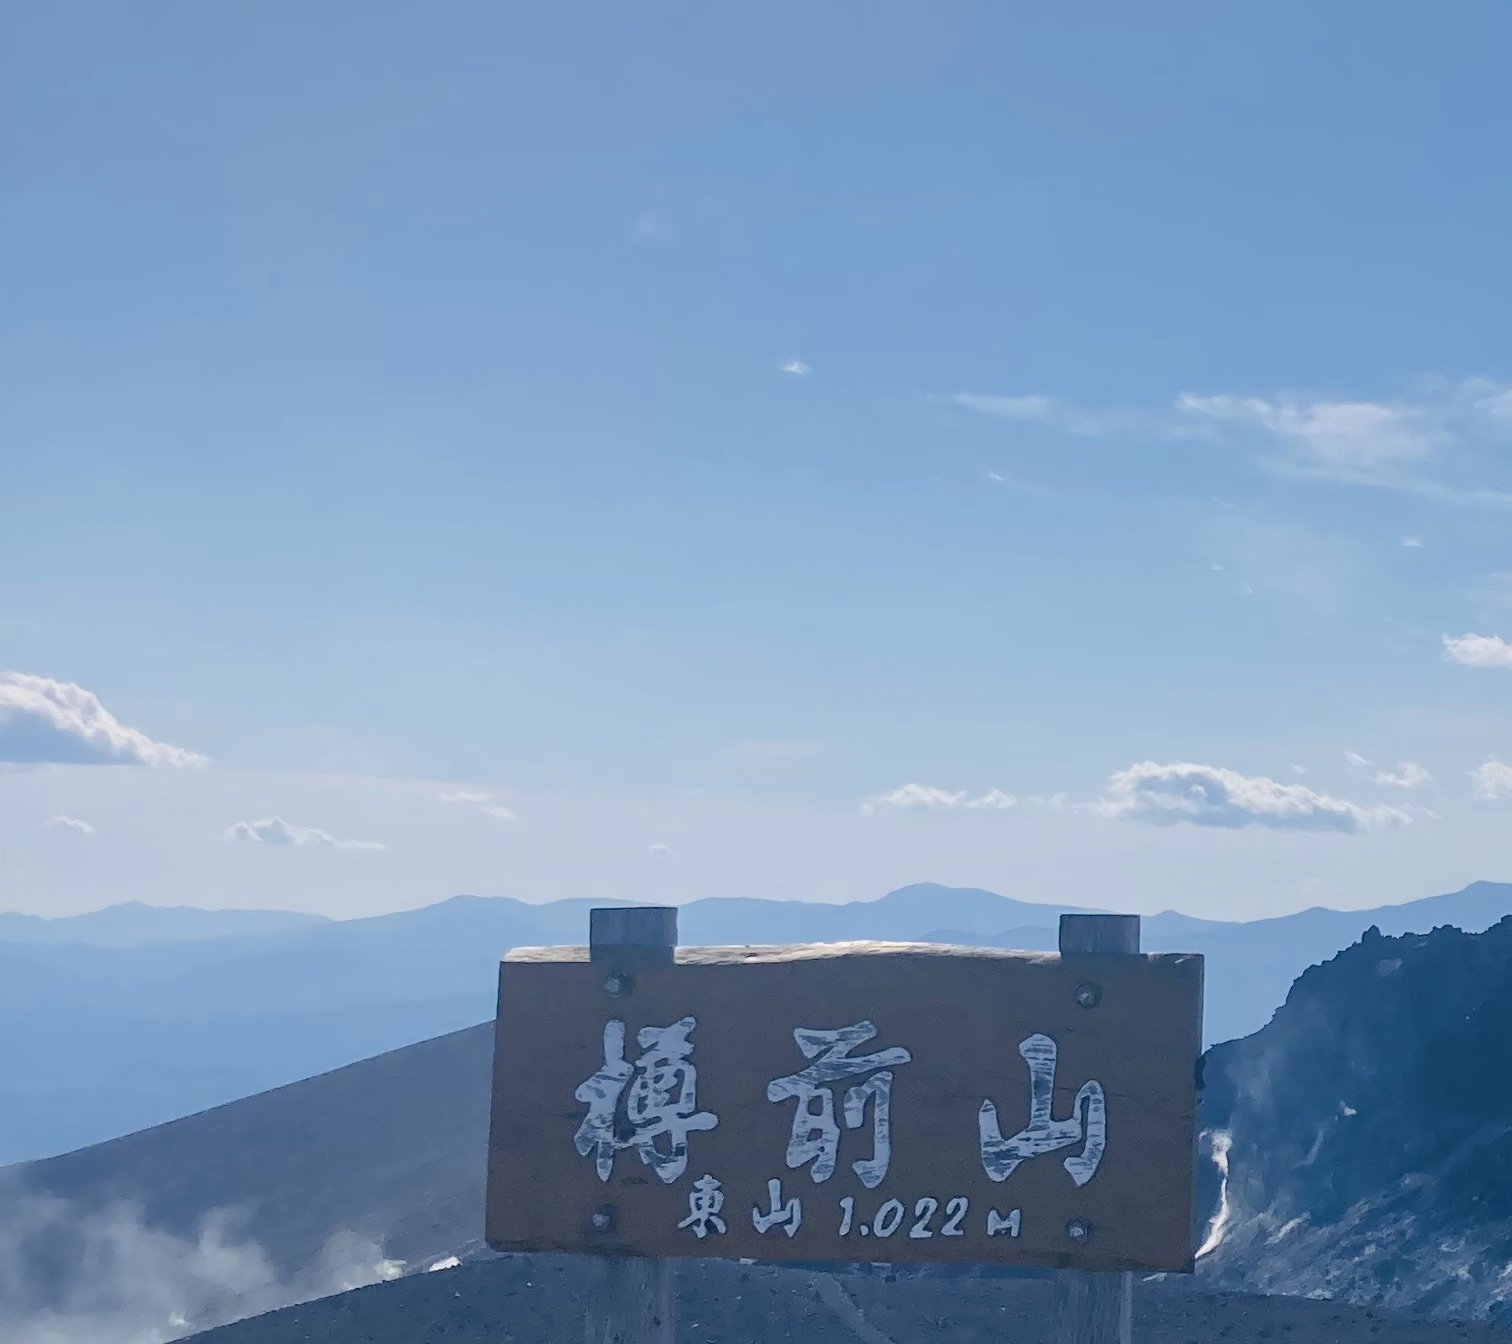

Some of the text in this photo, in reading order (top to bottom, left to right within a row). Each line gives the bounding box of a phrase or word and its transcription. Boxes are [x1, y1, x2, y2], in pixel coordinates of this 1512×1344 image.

[574, 1016, 1107, 1189] 樽前山
[677, 1173, 802, 1239] 東山
[838, 1196, 969, 1239] 1.022
